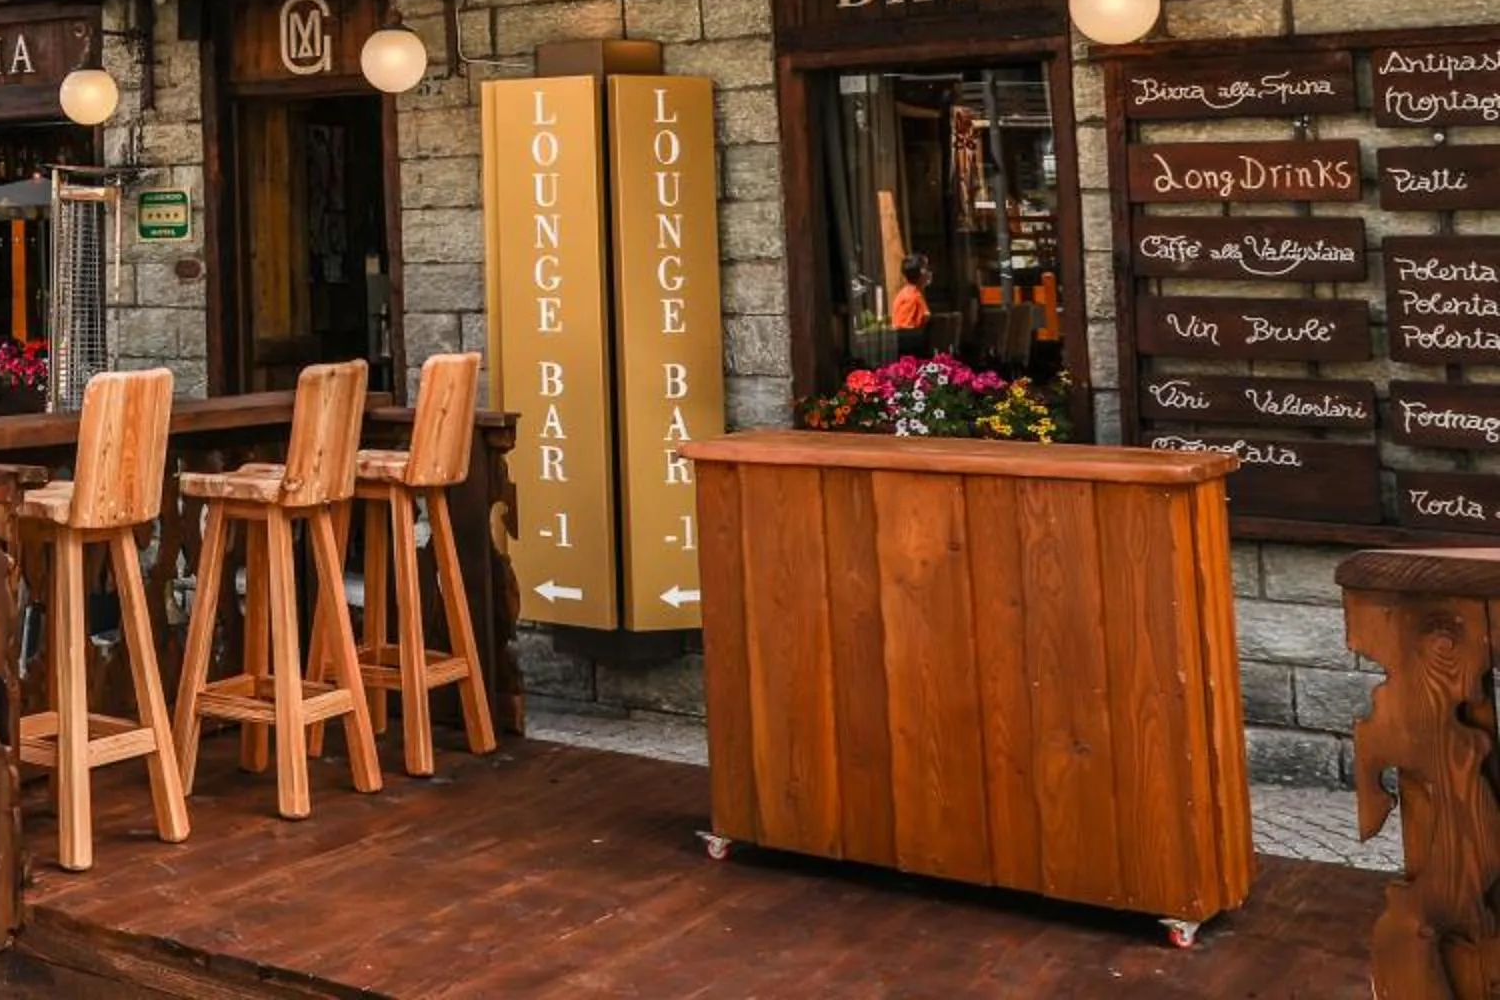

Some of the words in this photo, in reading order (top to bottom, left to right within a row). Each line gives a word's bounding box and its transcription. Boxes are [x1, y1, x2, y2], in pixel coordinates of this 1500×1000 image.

[1385, 86, 1500, 123] Montag
[1152, 153, 1235, 198] Long
[1386, 167, 1469, 193] Piatti
[531, 90, 564, 333] LOUNGE
[653, 88, 686, 333] LOUNGE
[1393, 257, 1499, 282] Polenta
[1397, 290, 1500, 316] Polenta
[1166, 313, 1221, 347] Vin
[1400, 324, 1500, 349] Polenta
[1150, 379, 1211, 410] Vini
[1245, 388, 1368, 420] Valdostani
[538, 361, 569, 482] BAR
[663, 363, 693, 485] BAR
[1409, 489, 1487, 521] Torta
[538, 512, 573, 548] -1
[663, 515, 697, 550] -1
